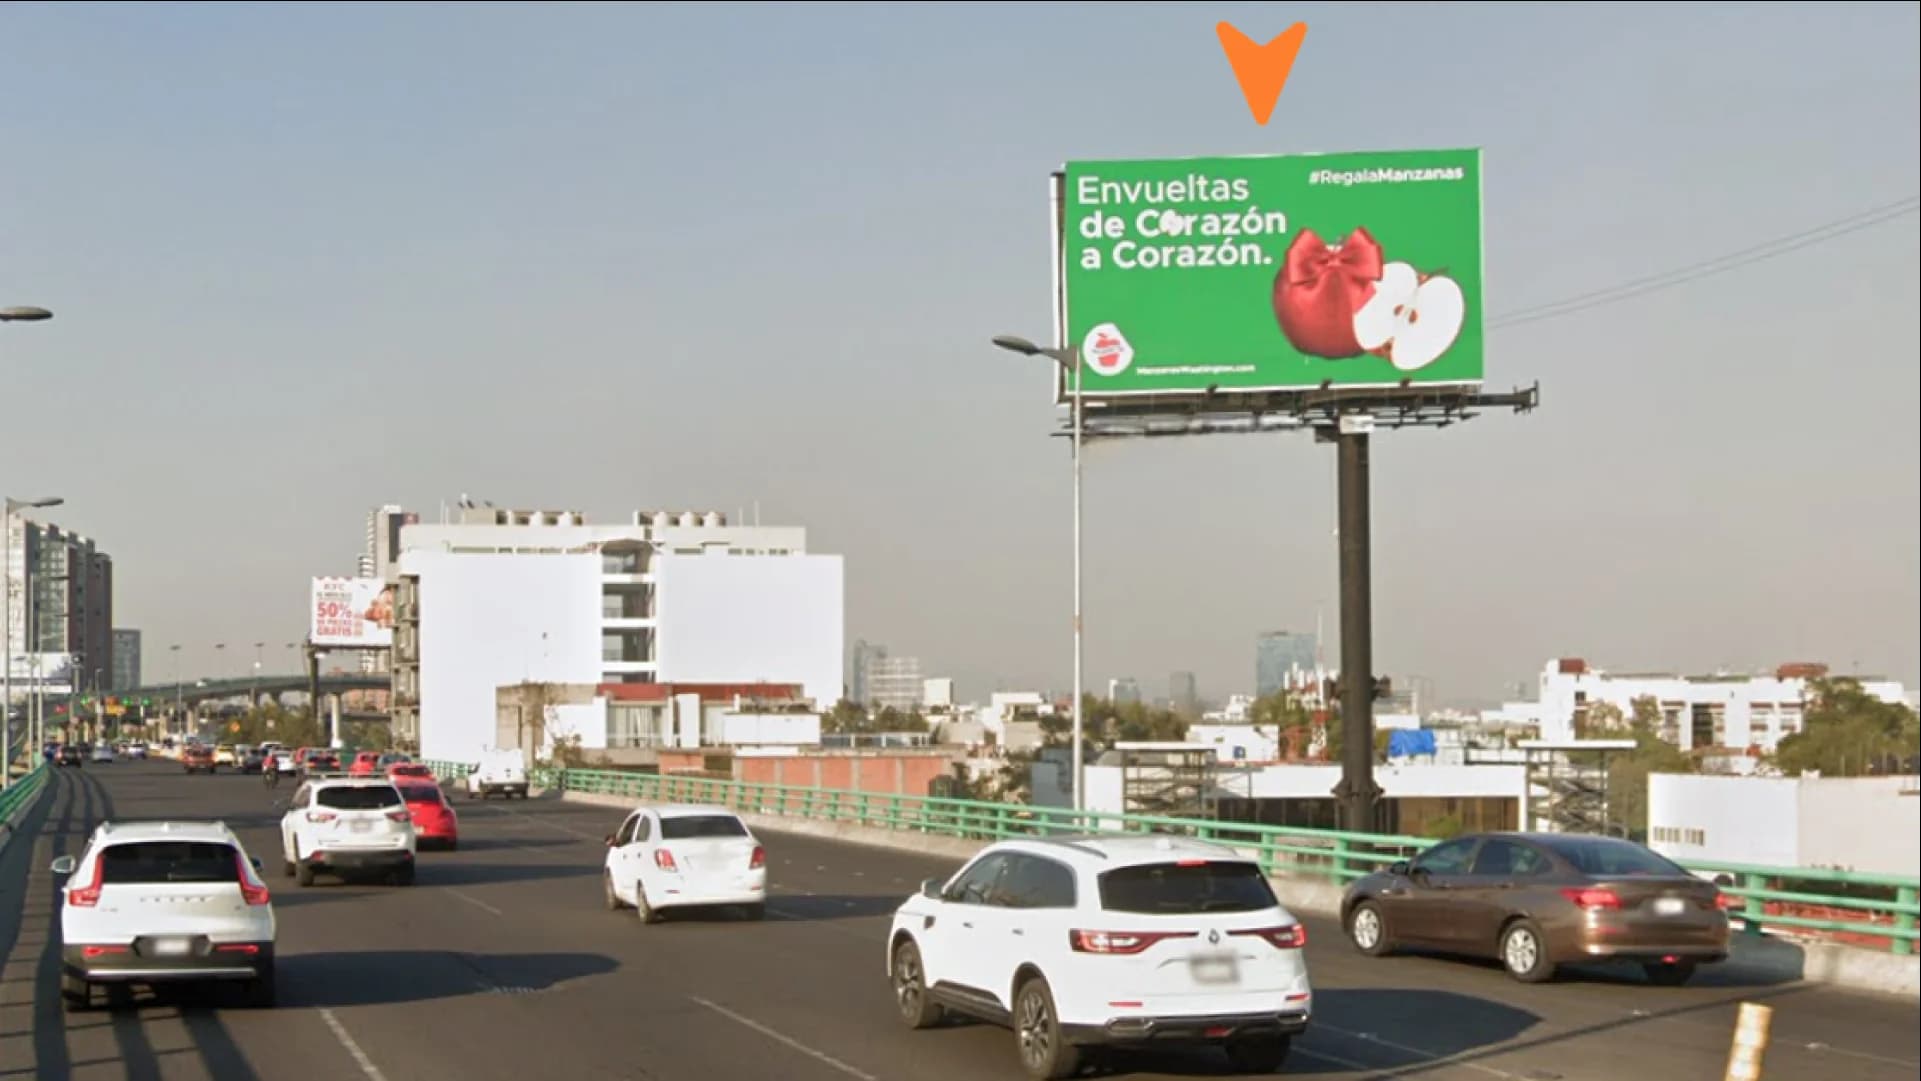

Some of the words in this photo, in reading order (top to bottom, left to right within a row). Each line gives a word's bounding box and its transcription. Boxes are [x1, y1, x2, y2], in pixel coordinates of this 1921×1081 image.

[1077, 174, 1250, 204] Envueltas
[1308, 166, 1465, 186] #RegalaManzanas
[1080, 209, 1125, 238] de
[1080, 246, 1101, 269] a
[1112, 237, 1273, 268] Corazón.
[317, 602, 352, 618] 50%
